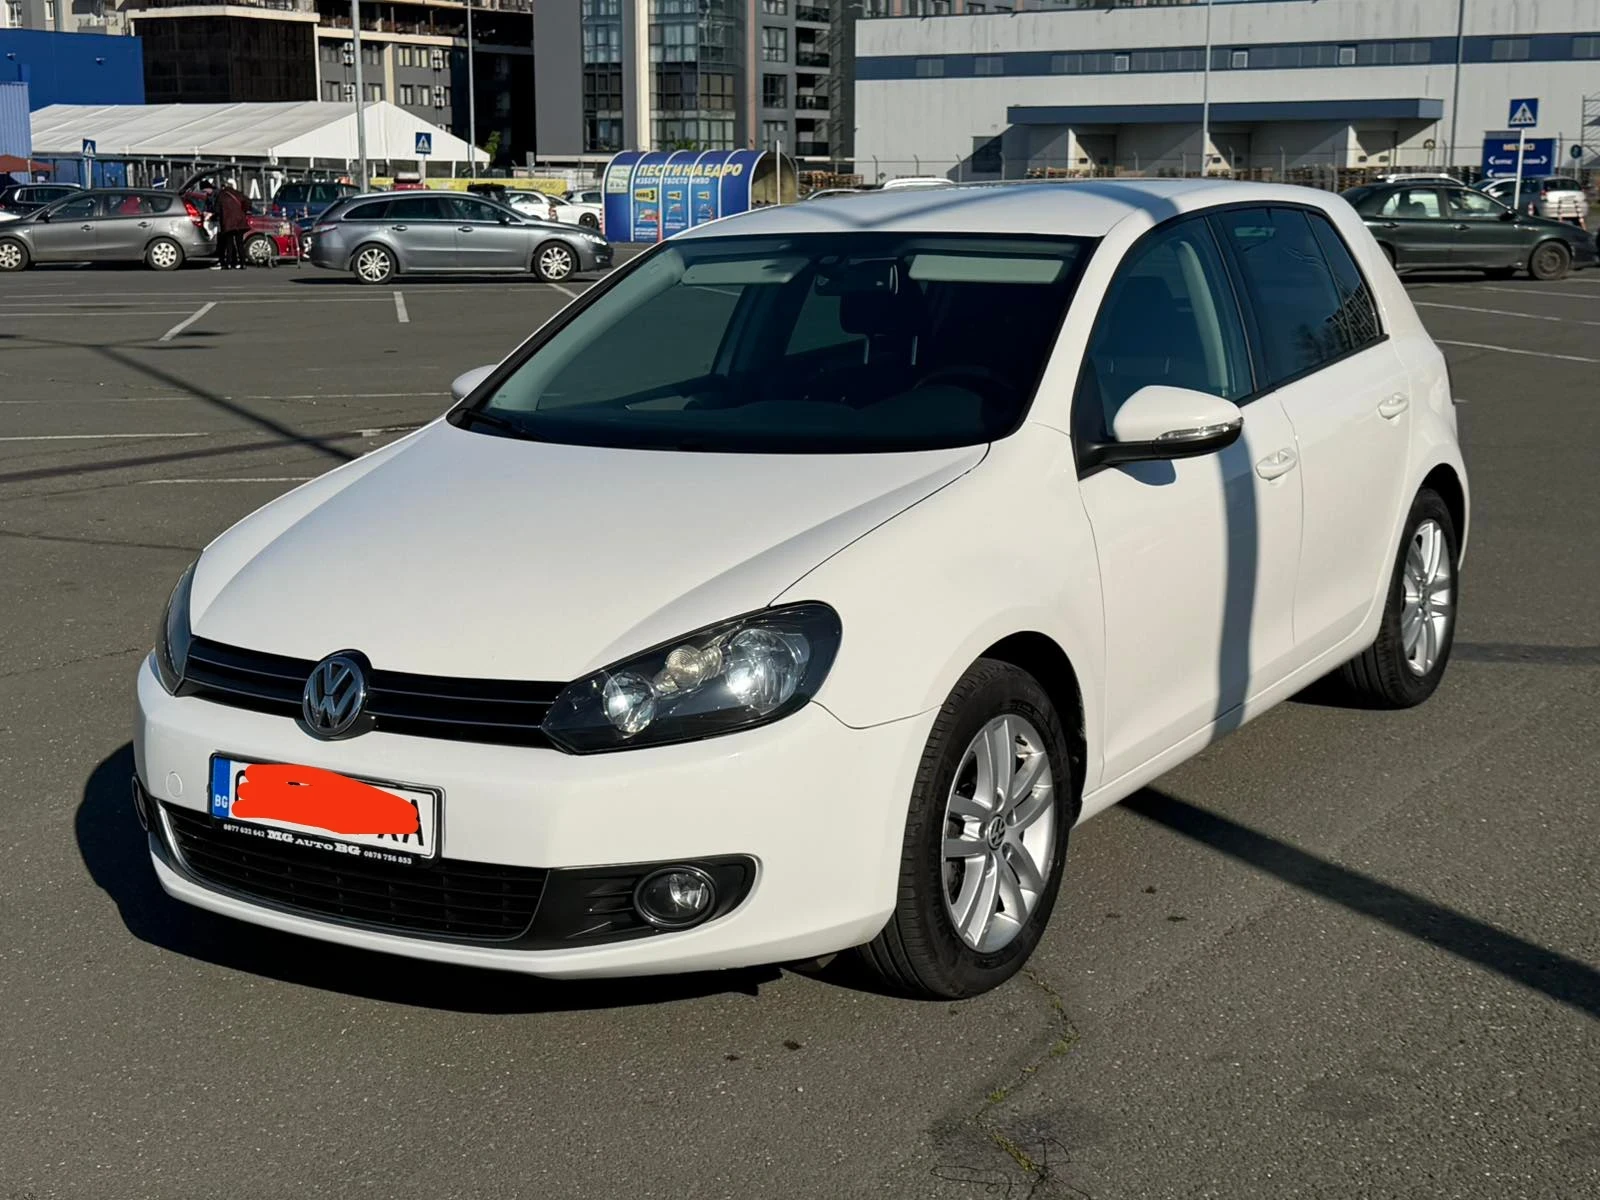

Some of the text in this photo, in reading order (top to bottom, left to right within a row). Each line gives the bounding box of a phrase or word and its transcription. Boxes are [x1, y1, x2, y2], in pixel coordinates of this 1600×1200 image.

[637, 163, 743, 177] ПЕСТИ НА ЕДРО
[214, 794, 228, 808] BG
[266, 830, 294, 843] MG
[295, 838, 334, 851] AUTO
[334, 842, 361, 856] BG
